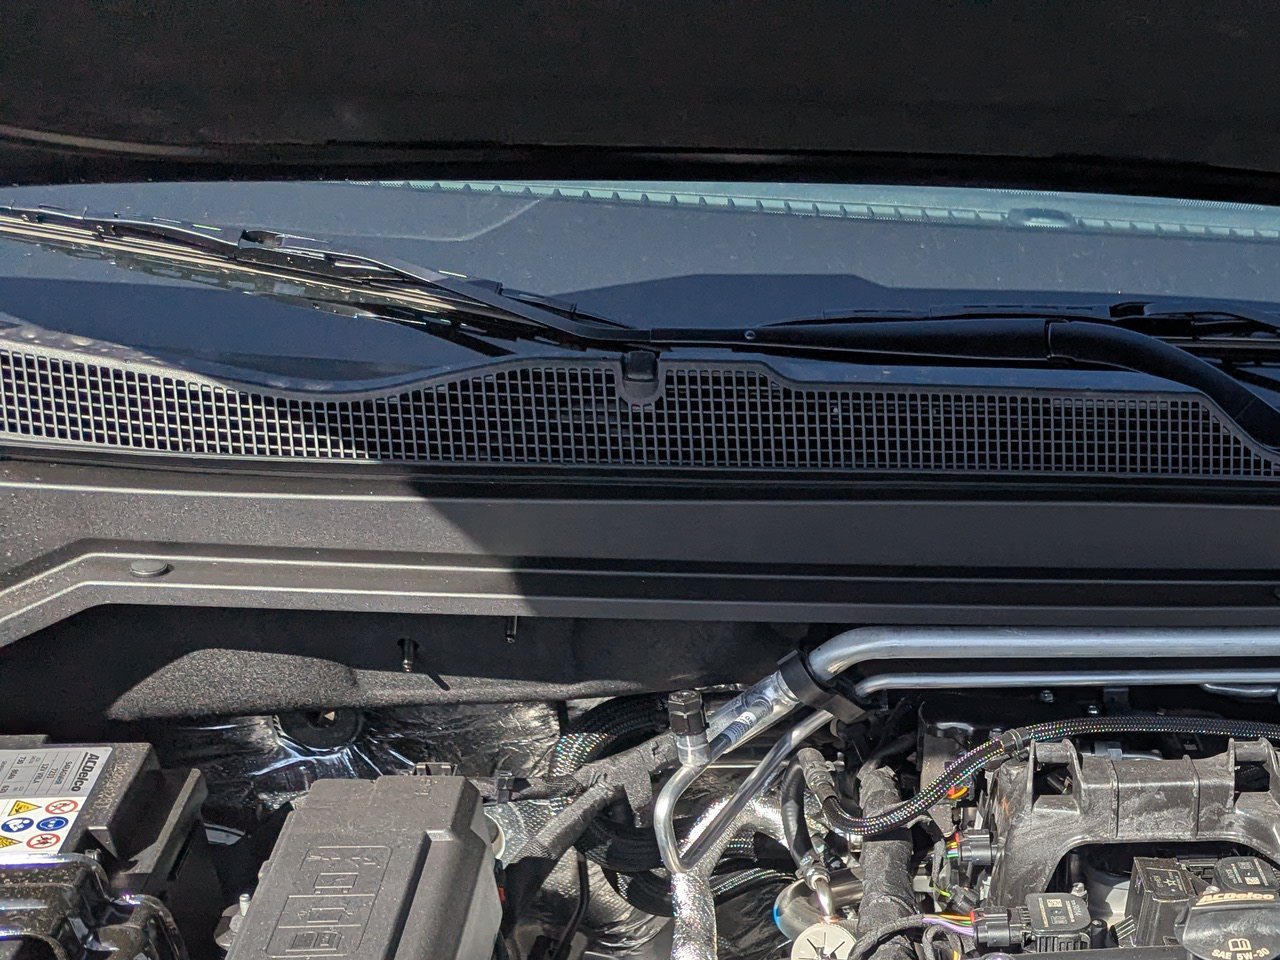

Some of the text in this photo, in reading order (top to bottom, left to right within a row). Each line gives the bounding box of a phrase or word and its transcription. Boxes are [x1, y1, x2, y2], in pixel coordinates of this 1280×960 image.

[70, 753, 99, 792] ACDelco
[1197, 891, 1275, 905] ACDelco
[1211, 947, 1270, 960] SAE 5W-30
